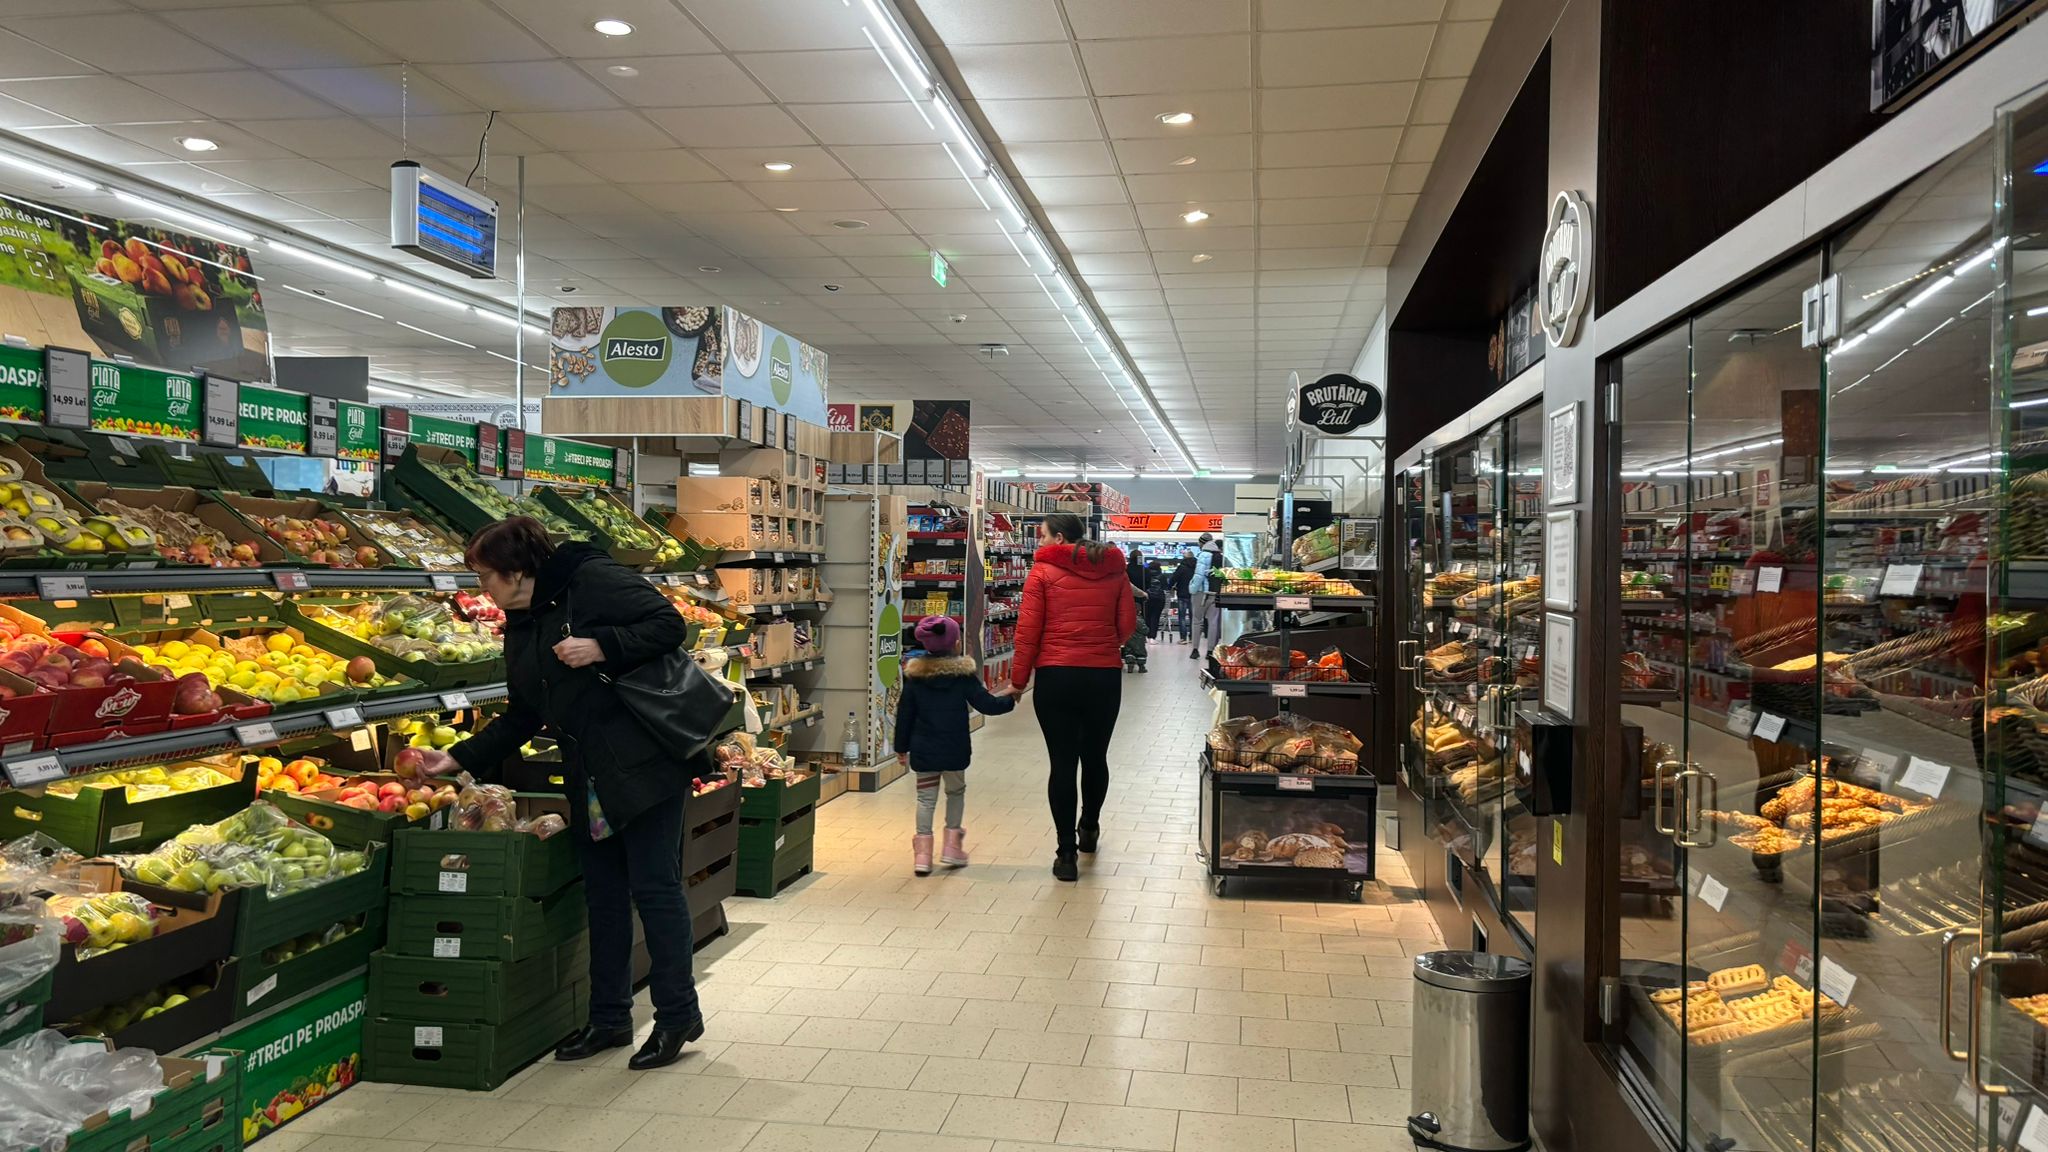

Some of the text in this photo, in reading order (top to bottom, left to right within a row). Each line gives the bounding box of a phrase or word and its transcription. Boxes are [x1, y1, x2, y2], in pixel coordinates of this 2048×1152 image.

[16, 210, 33, 224] de
[33, 216, 52, 229] pe
[610, 341, 659, 357] Alesto
[773, 361, 789, 379] Alesto
[53, 394, 87, 407] 14,99 Lei
[94, 390, 117, 407] Lidl
[1306, 384, 1368, 406] BRUTĂRIA
[226, 418, 235, 427] Lei
[260, 407, 274, 421] PE
[1317, 408, 1354, 425] Lidl
[456, 436, 465, 448] PE
[465, 438, 478, 449] PR
[880, 638, 897, 655] Alesto
[247, 1033, 294, 1073] #TRECI
[296, 1023, 313, 1048] PE
